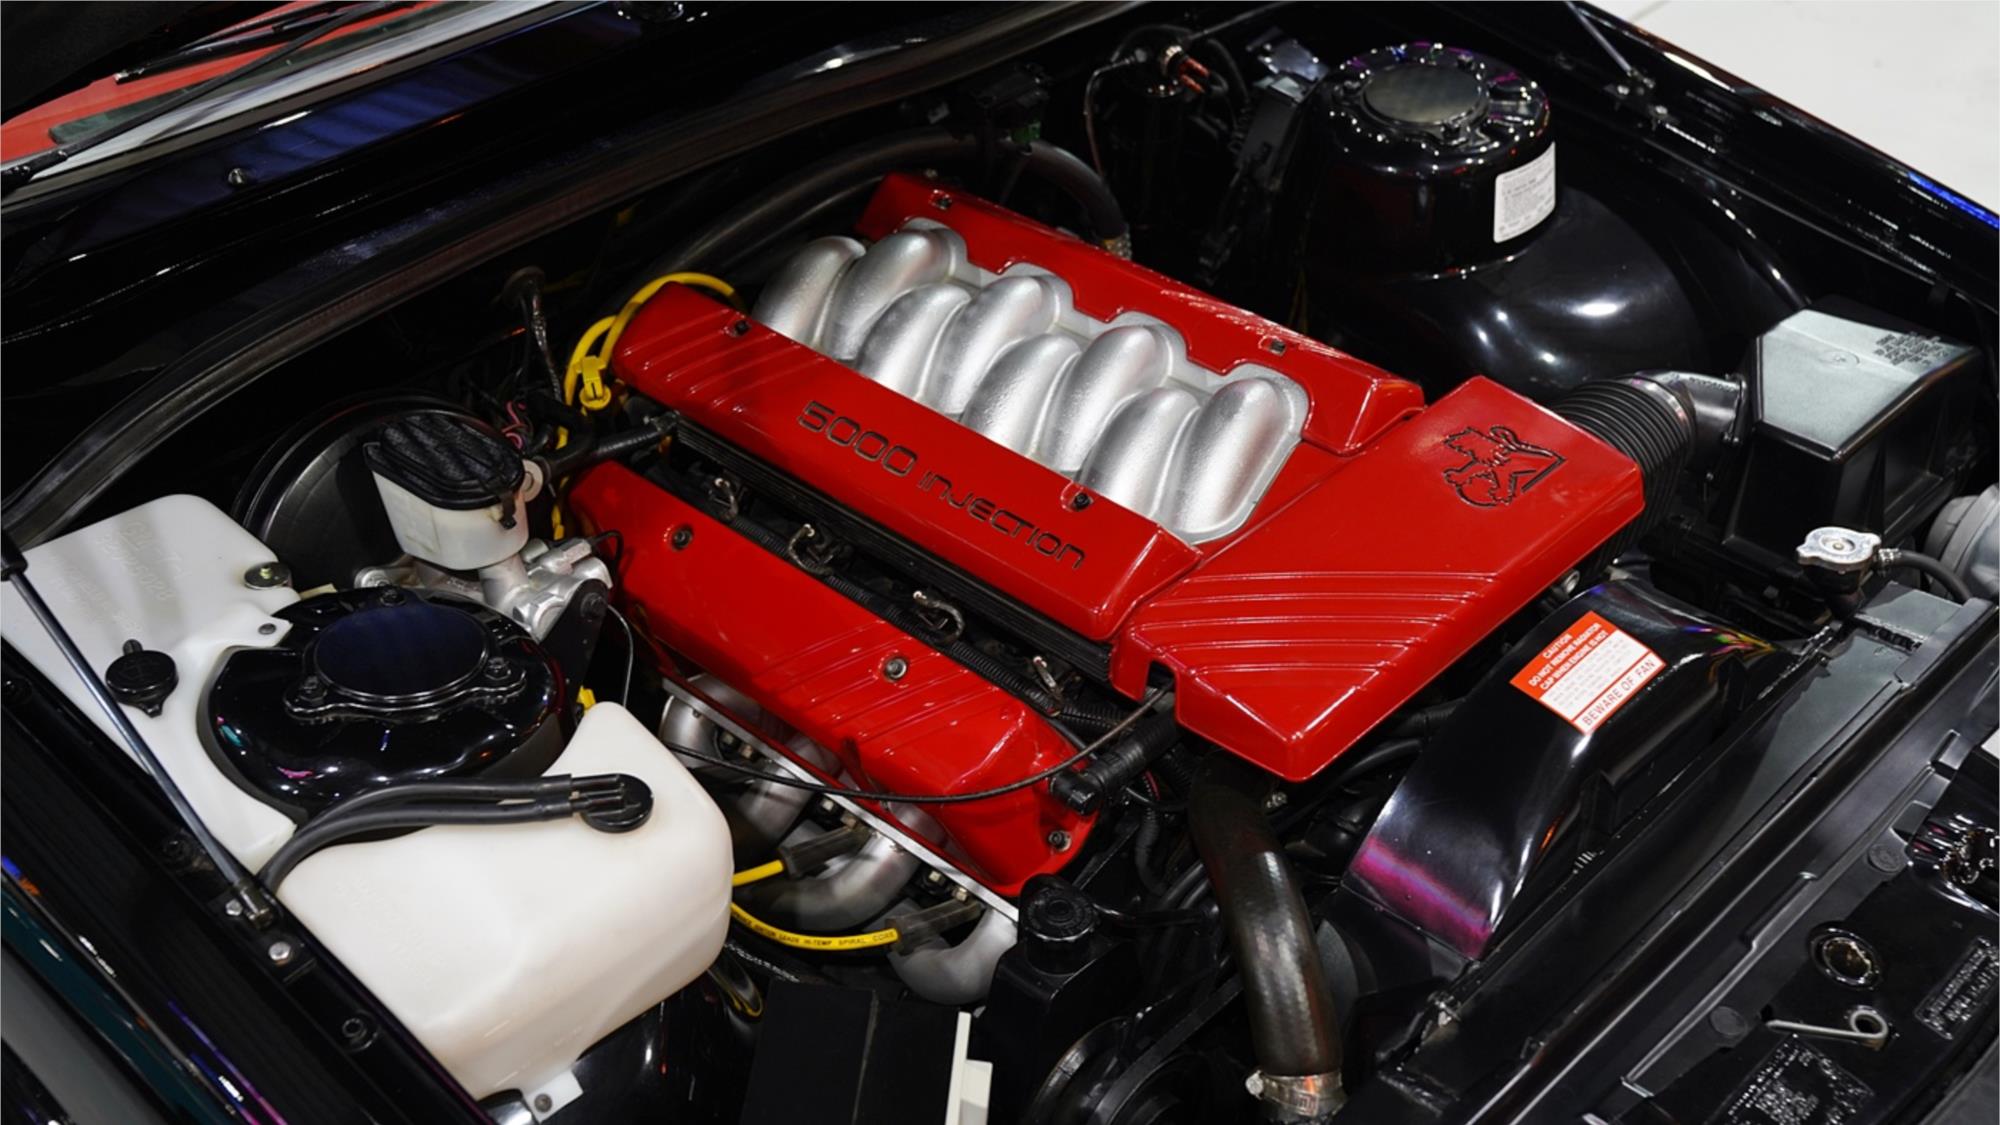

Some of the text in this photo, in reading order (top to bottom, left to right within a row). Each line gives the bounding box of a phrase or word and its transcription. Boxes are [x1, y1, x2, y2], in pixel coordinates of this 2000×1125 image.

[797, 400, 1086, 569] 5000 INJECTION
[1527, 622, 1601, 687] DO NOT REMOVE RADIATOR
[1539, 676, 1555, 690] CAP
[1552, 660, 1573, 680] WHEN
[1567, 643, 1592, 665] ENGINE
[1594, 629, 1609, 643] HOT
[1542, 632, 1573, 660] CAUTION
[1582, 659, 1656, 726] BEWARE OF FAN
[838, 936, 866, 946] SPIRAL
[871, 930, 895, 942] CORE
